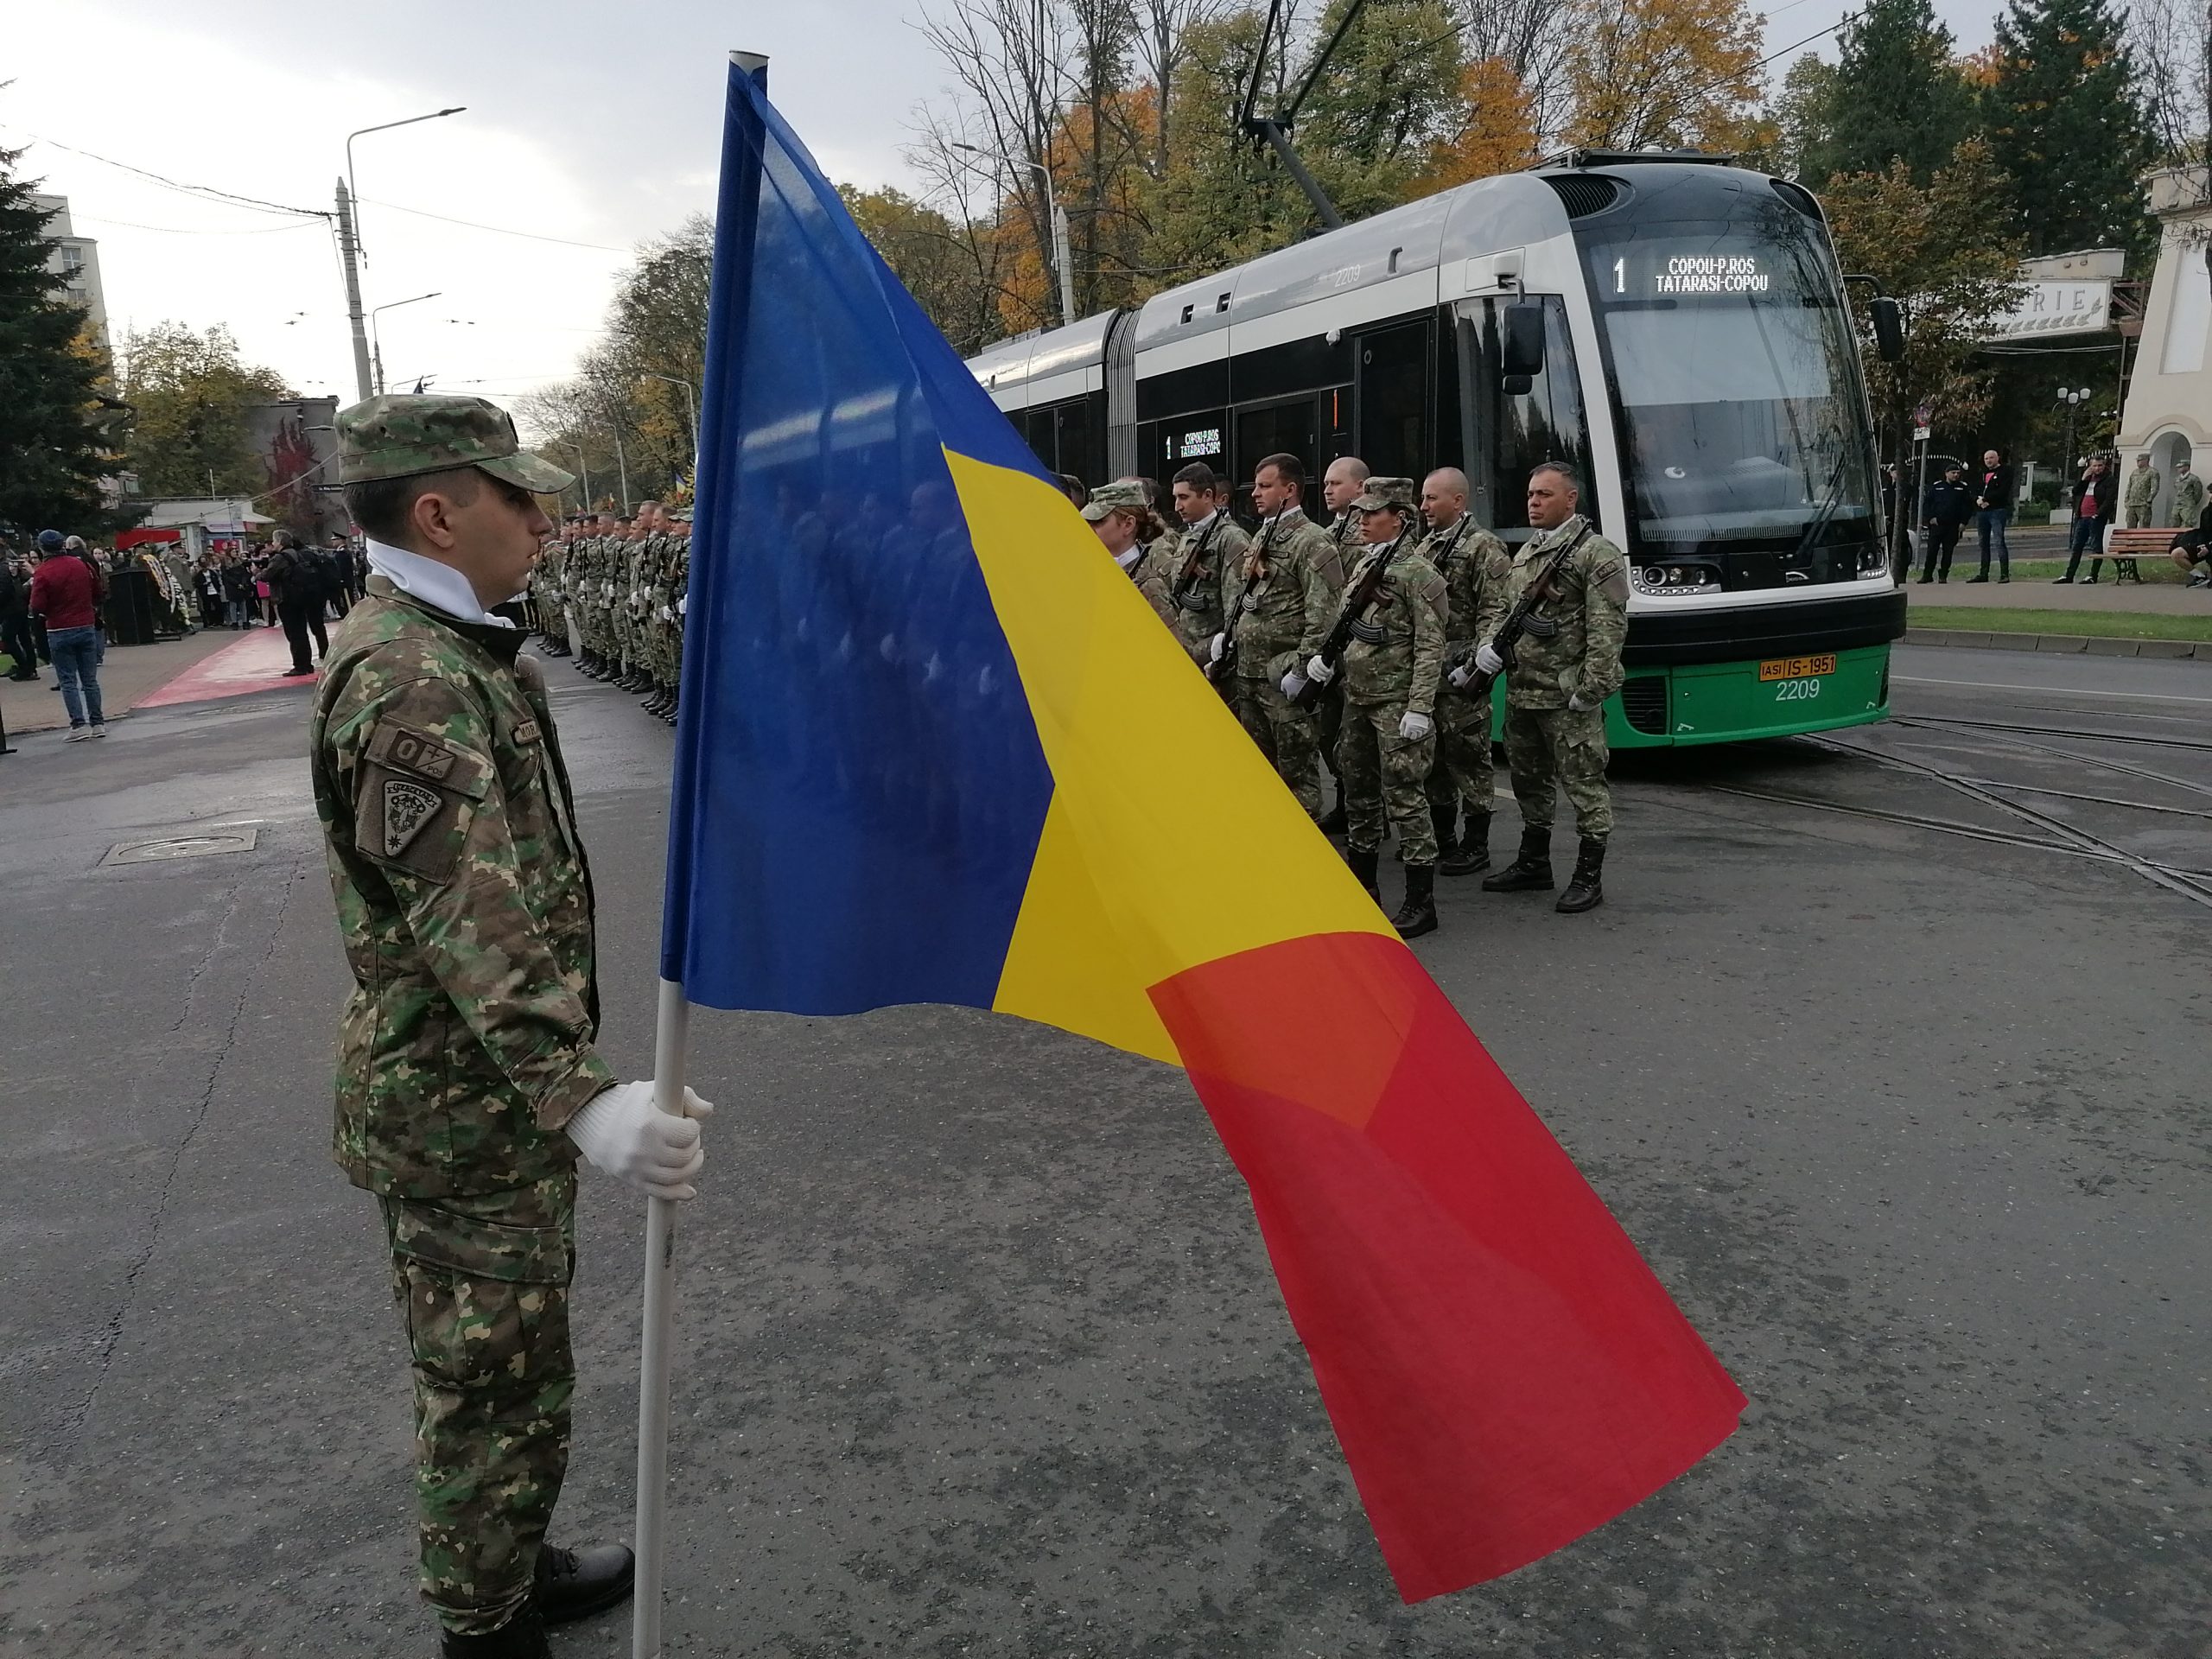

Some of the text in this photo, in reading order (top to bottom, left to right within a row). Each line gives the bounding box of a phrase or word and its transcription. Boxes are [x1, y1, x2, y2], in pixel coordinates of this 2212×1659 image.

[1335, 264, 1360, 287] 2209
[1614, 257, 1755, 293] 1 COPOU-P.ROS
[1656, 275, 1769, 292] TATARASI-COPOU
[2022, 289, 2086, 311] RIE
[1166, 436, 1172, 460] 1
[1763, 657, 1834, 676] IASI IS-1951
[1776, 679, 1820, 701] 2209
[427, 766, 443, 777] POS
